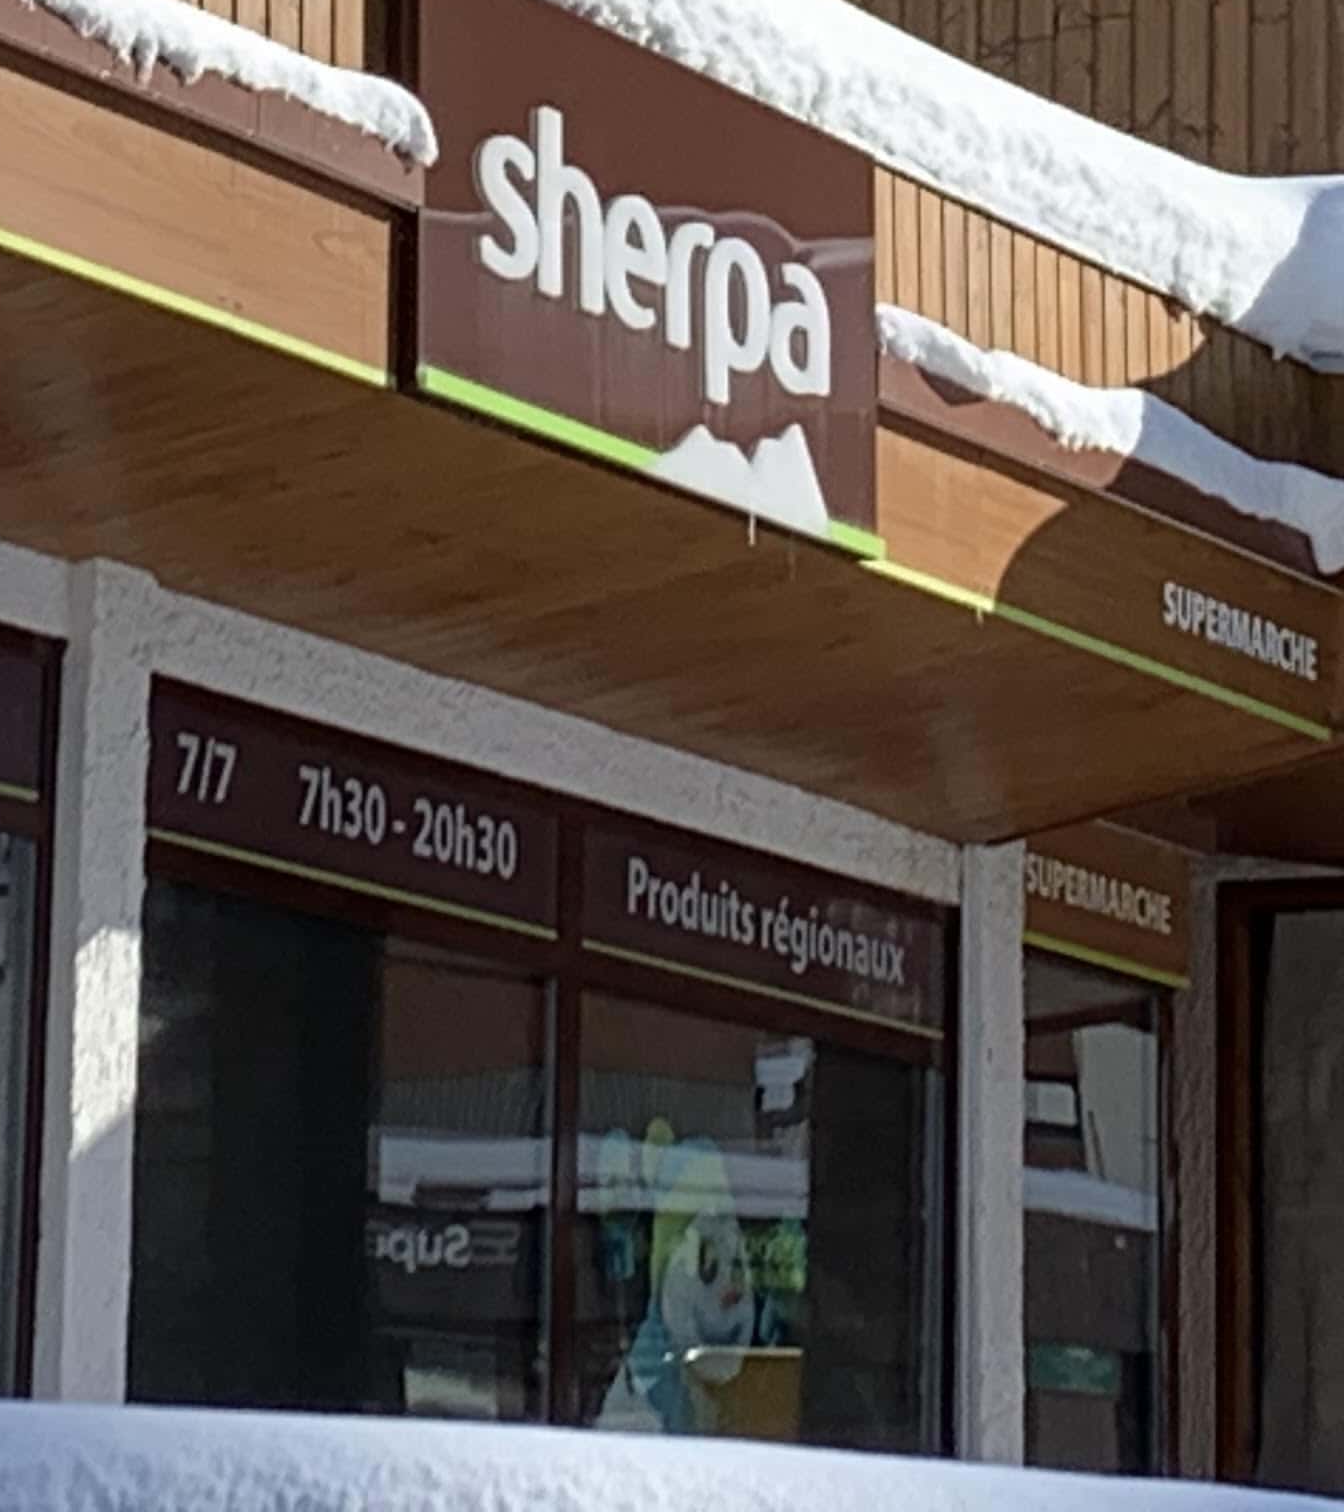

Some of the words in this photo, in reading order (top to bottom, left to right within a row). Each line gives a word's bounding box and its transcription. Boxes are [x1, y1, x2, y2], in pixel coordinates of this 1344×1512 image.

[474, 103, 833, 405] sherpa
[1161, 580, 1318, 682] SUPERMARCHE
[175, 731, 238, 804] 7/7
[297, 764, 388, 846] 7h30
[411, 797, 519, 881] 20h30
[626, 856, 755, 946] Produits
[759, 894, 906, 985] régionaux
[1026, 852, 1173, 938] SUPERMARCHE
